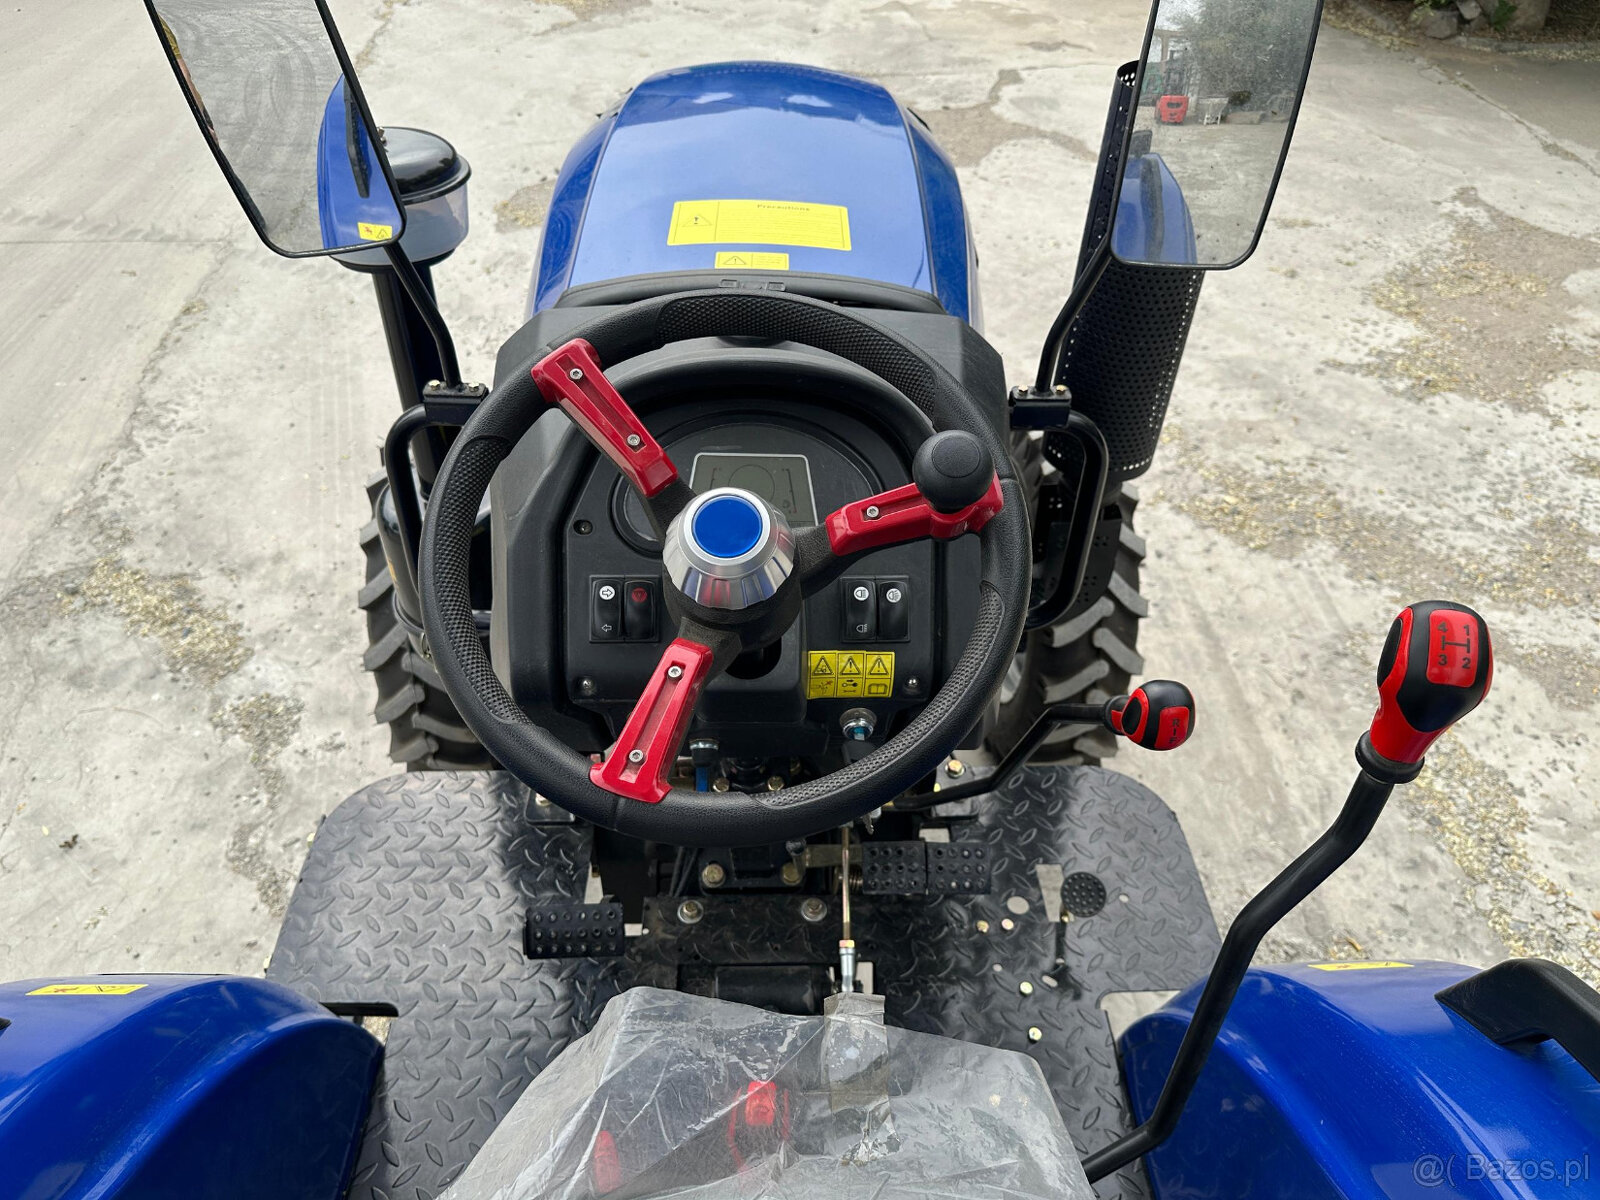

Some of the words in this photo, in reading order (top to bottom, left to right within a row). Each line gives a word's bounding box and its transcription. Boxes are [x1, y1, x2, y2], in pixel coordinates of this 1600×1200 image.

[1437, 622, 1448, 633] 4
[1463, 624, 1470, 636] 1
[1438, 654, 1448, 666] 3
[1462, 657, 1471, 669] 2
